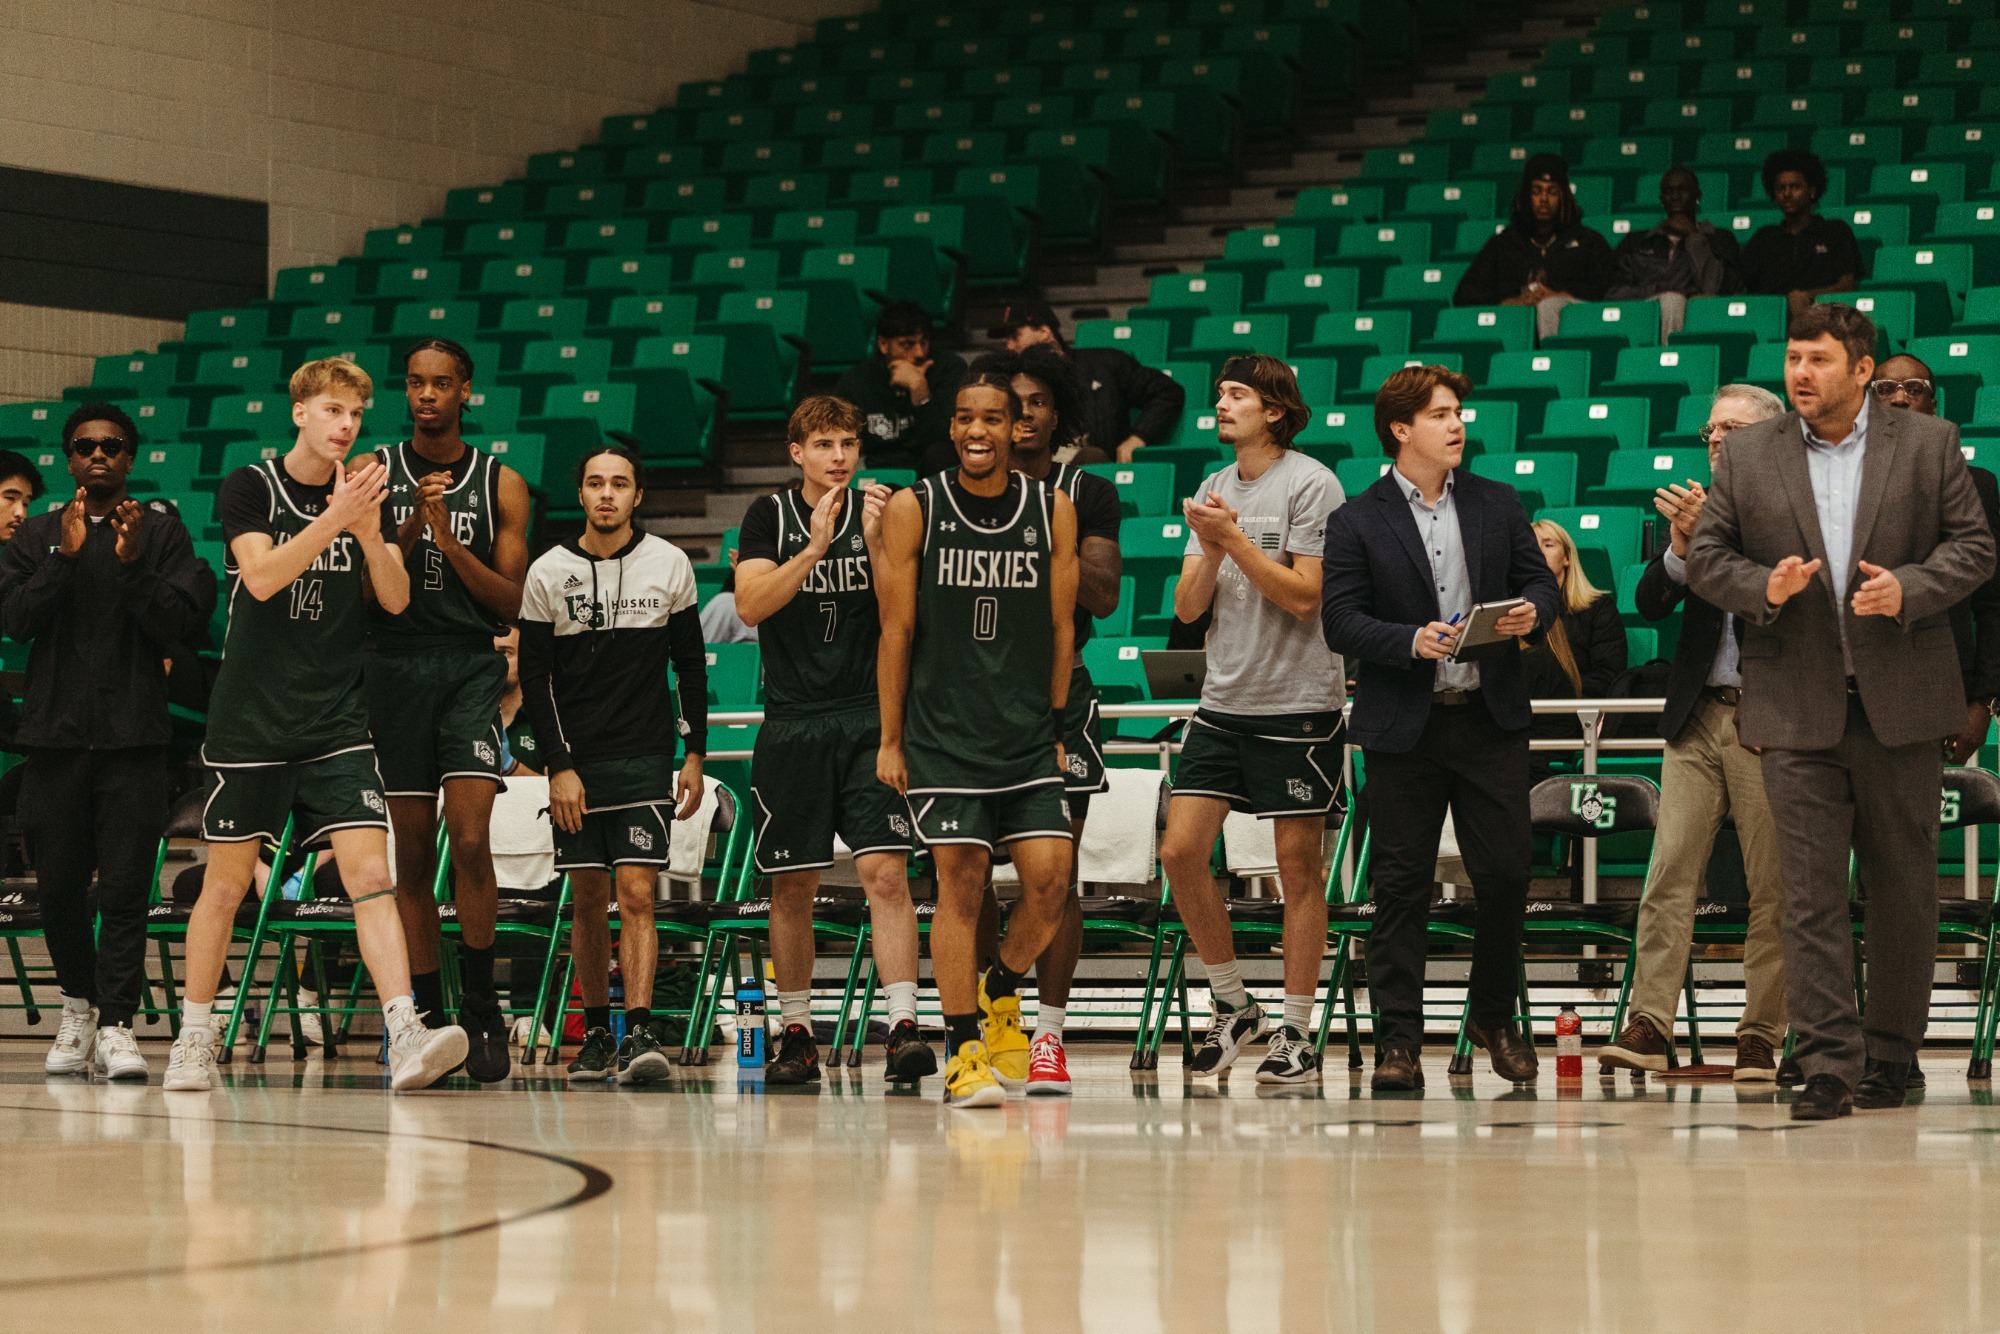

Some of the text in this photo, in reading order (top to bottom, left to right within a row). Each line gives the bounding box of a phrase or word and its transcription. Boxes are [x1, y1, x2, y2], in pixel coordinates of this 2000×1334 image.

[424, 549, 443, 591] 5
[563, 581, 583, 590] adidas
[789, 556, 868, 593] USKIES
[937, 548, 1039, 588] HUSKIES
[290, 579, 323, 621] 14
[611, 598, 660, 610] HUSKIE
[973, 596, 998, 640] 0
[819, 601, 837, 642] 7
[295, 902, 334, 916] Huskies
[1695, 903, 1727, 915] uskies
